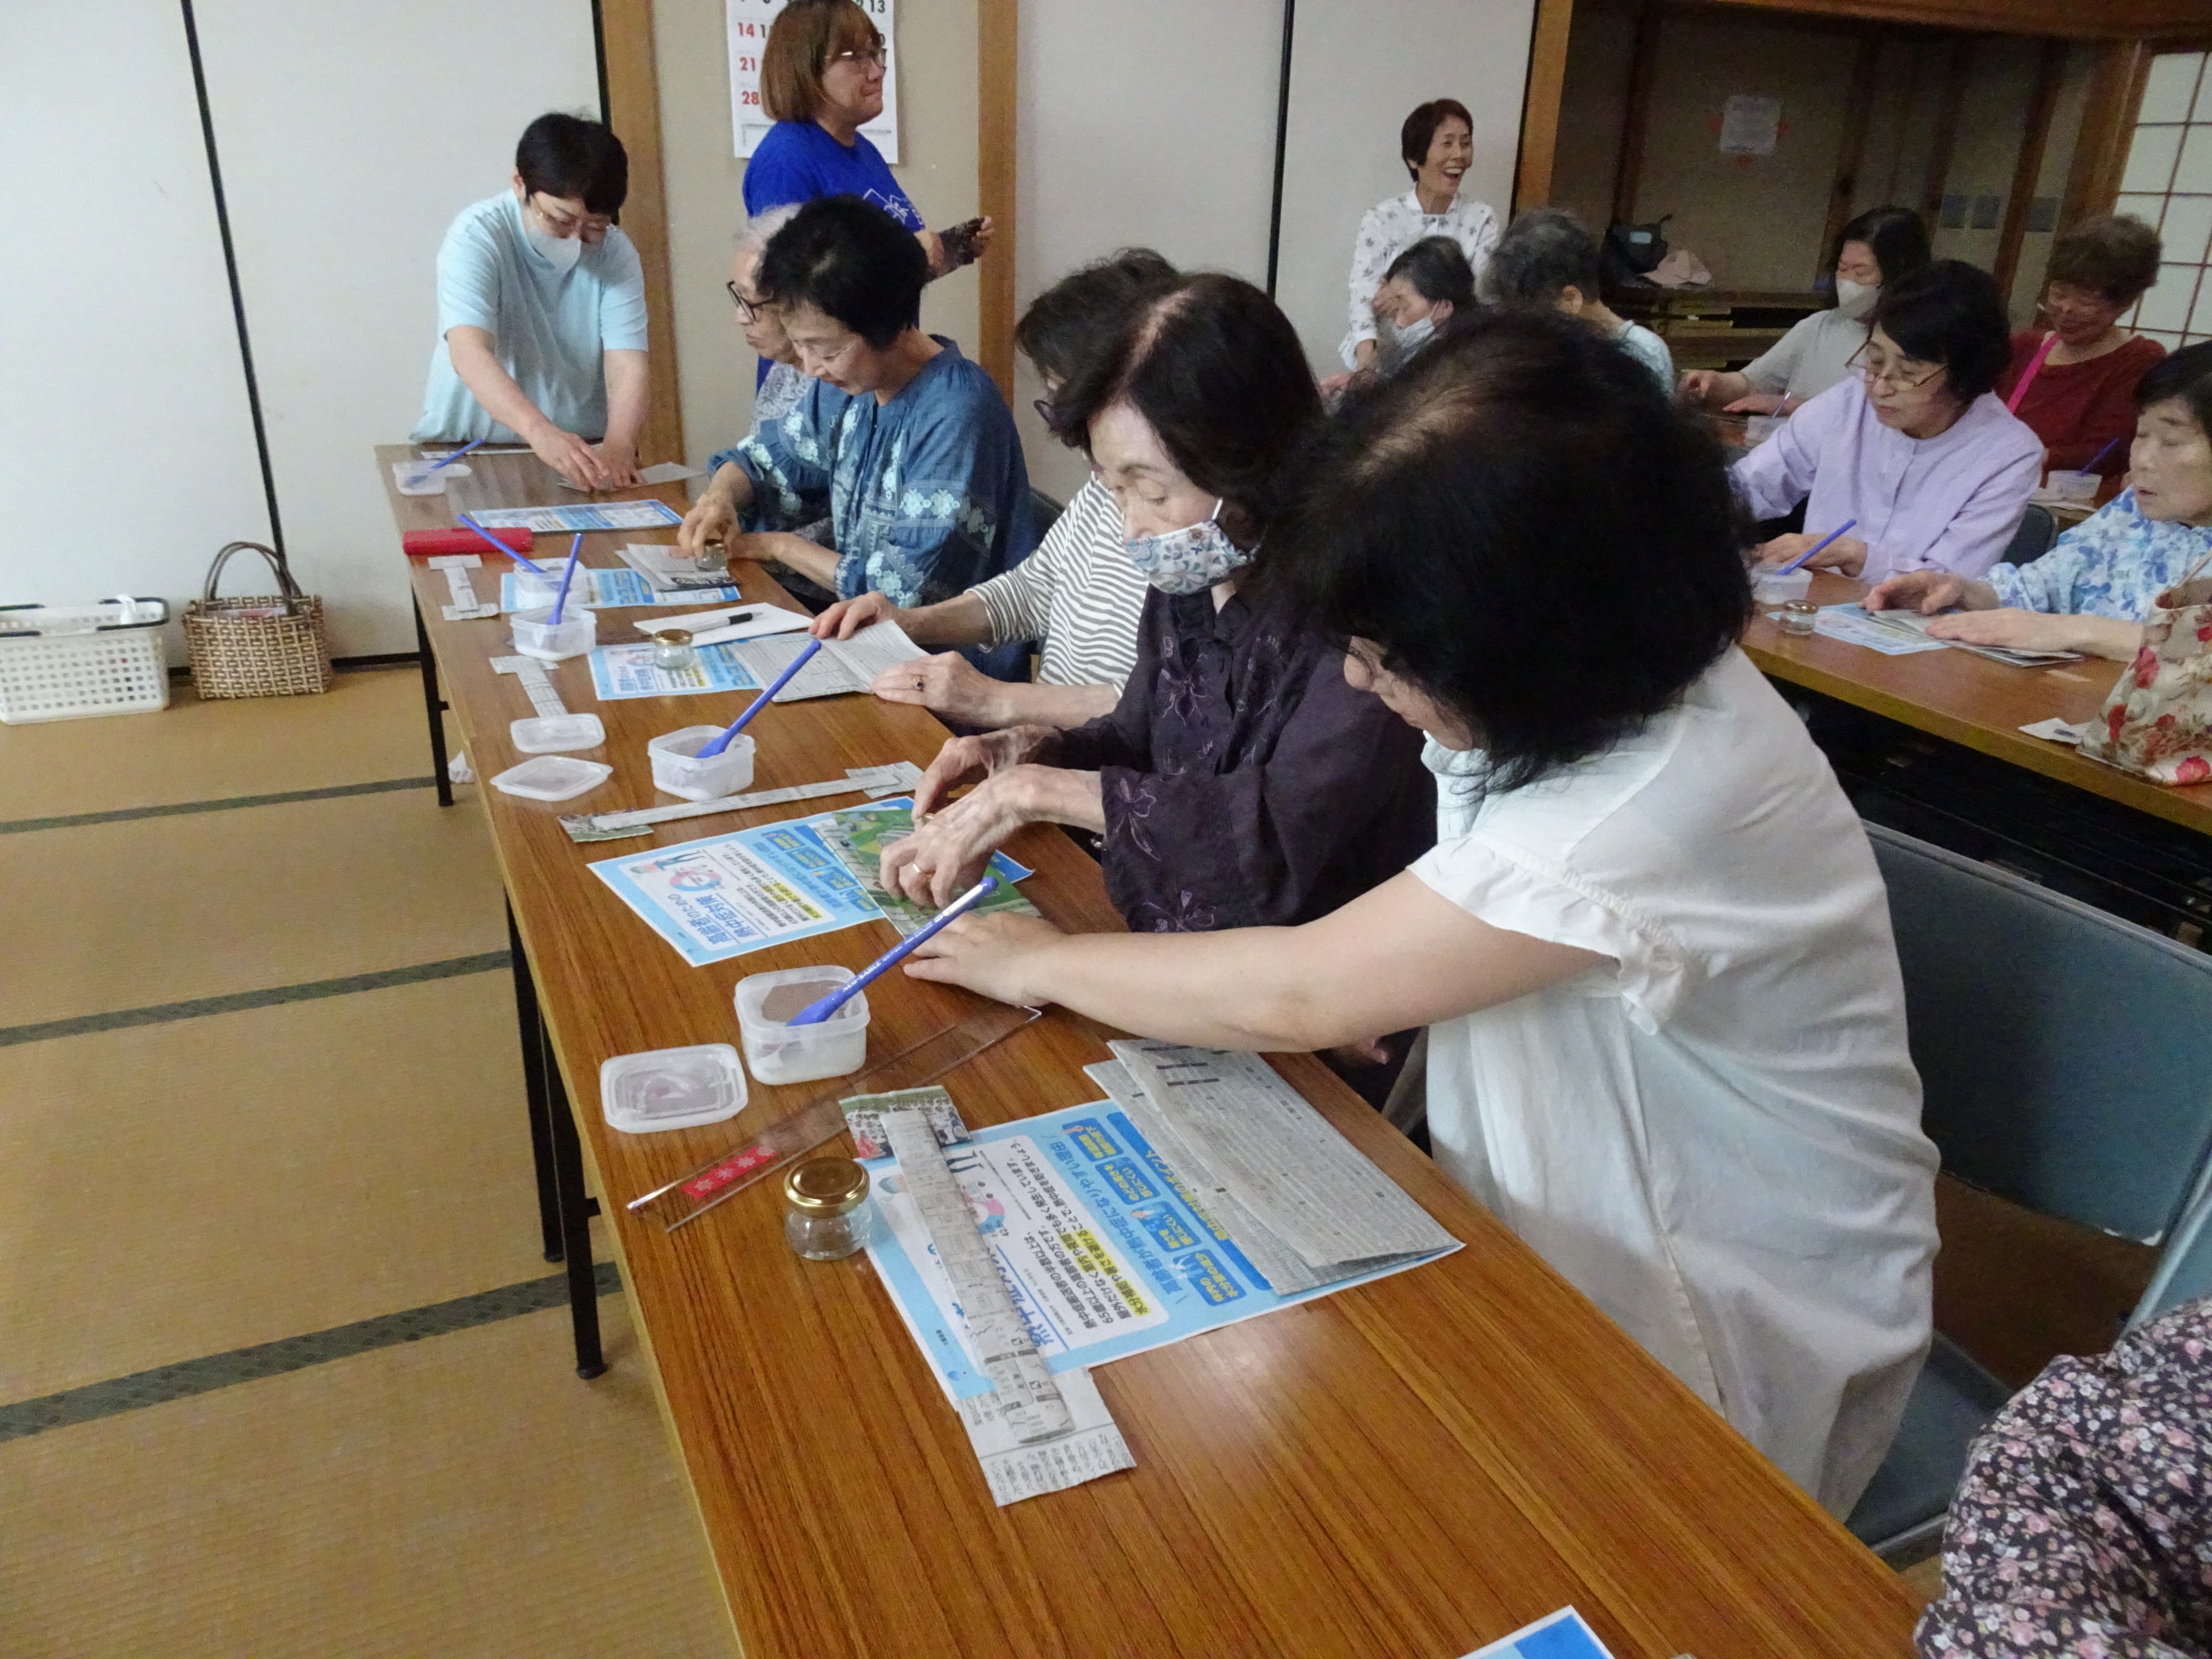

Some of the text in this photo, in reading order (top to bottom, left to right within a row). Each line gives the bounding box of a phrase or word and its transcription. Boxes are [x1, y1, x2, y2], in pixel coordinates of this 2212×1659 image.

[870, 0, 885, 13] 13
[738, 22, 755, 37] 14
[739, 57, 756, 71] 21
[741, 91, 760, 105] 28
[664, 892, 733, 945] 高齢者のための
[693, 894, 758, 939] 熱中症対策
[1048, 1140, 1182, 1294] 高齢者が熱中症になりやすい理由
[1035, 1224, 1114, 1325] 65歳以上の高齢者の方です。
